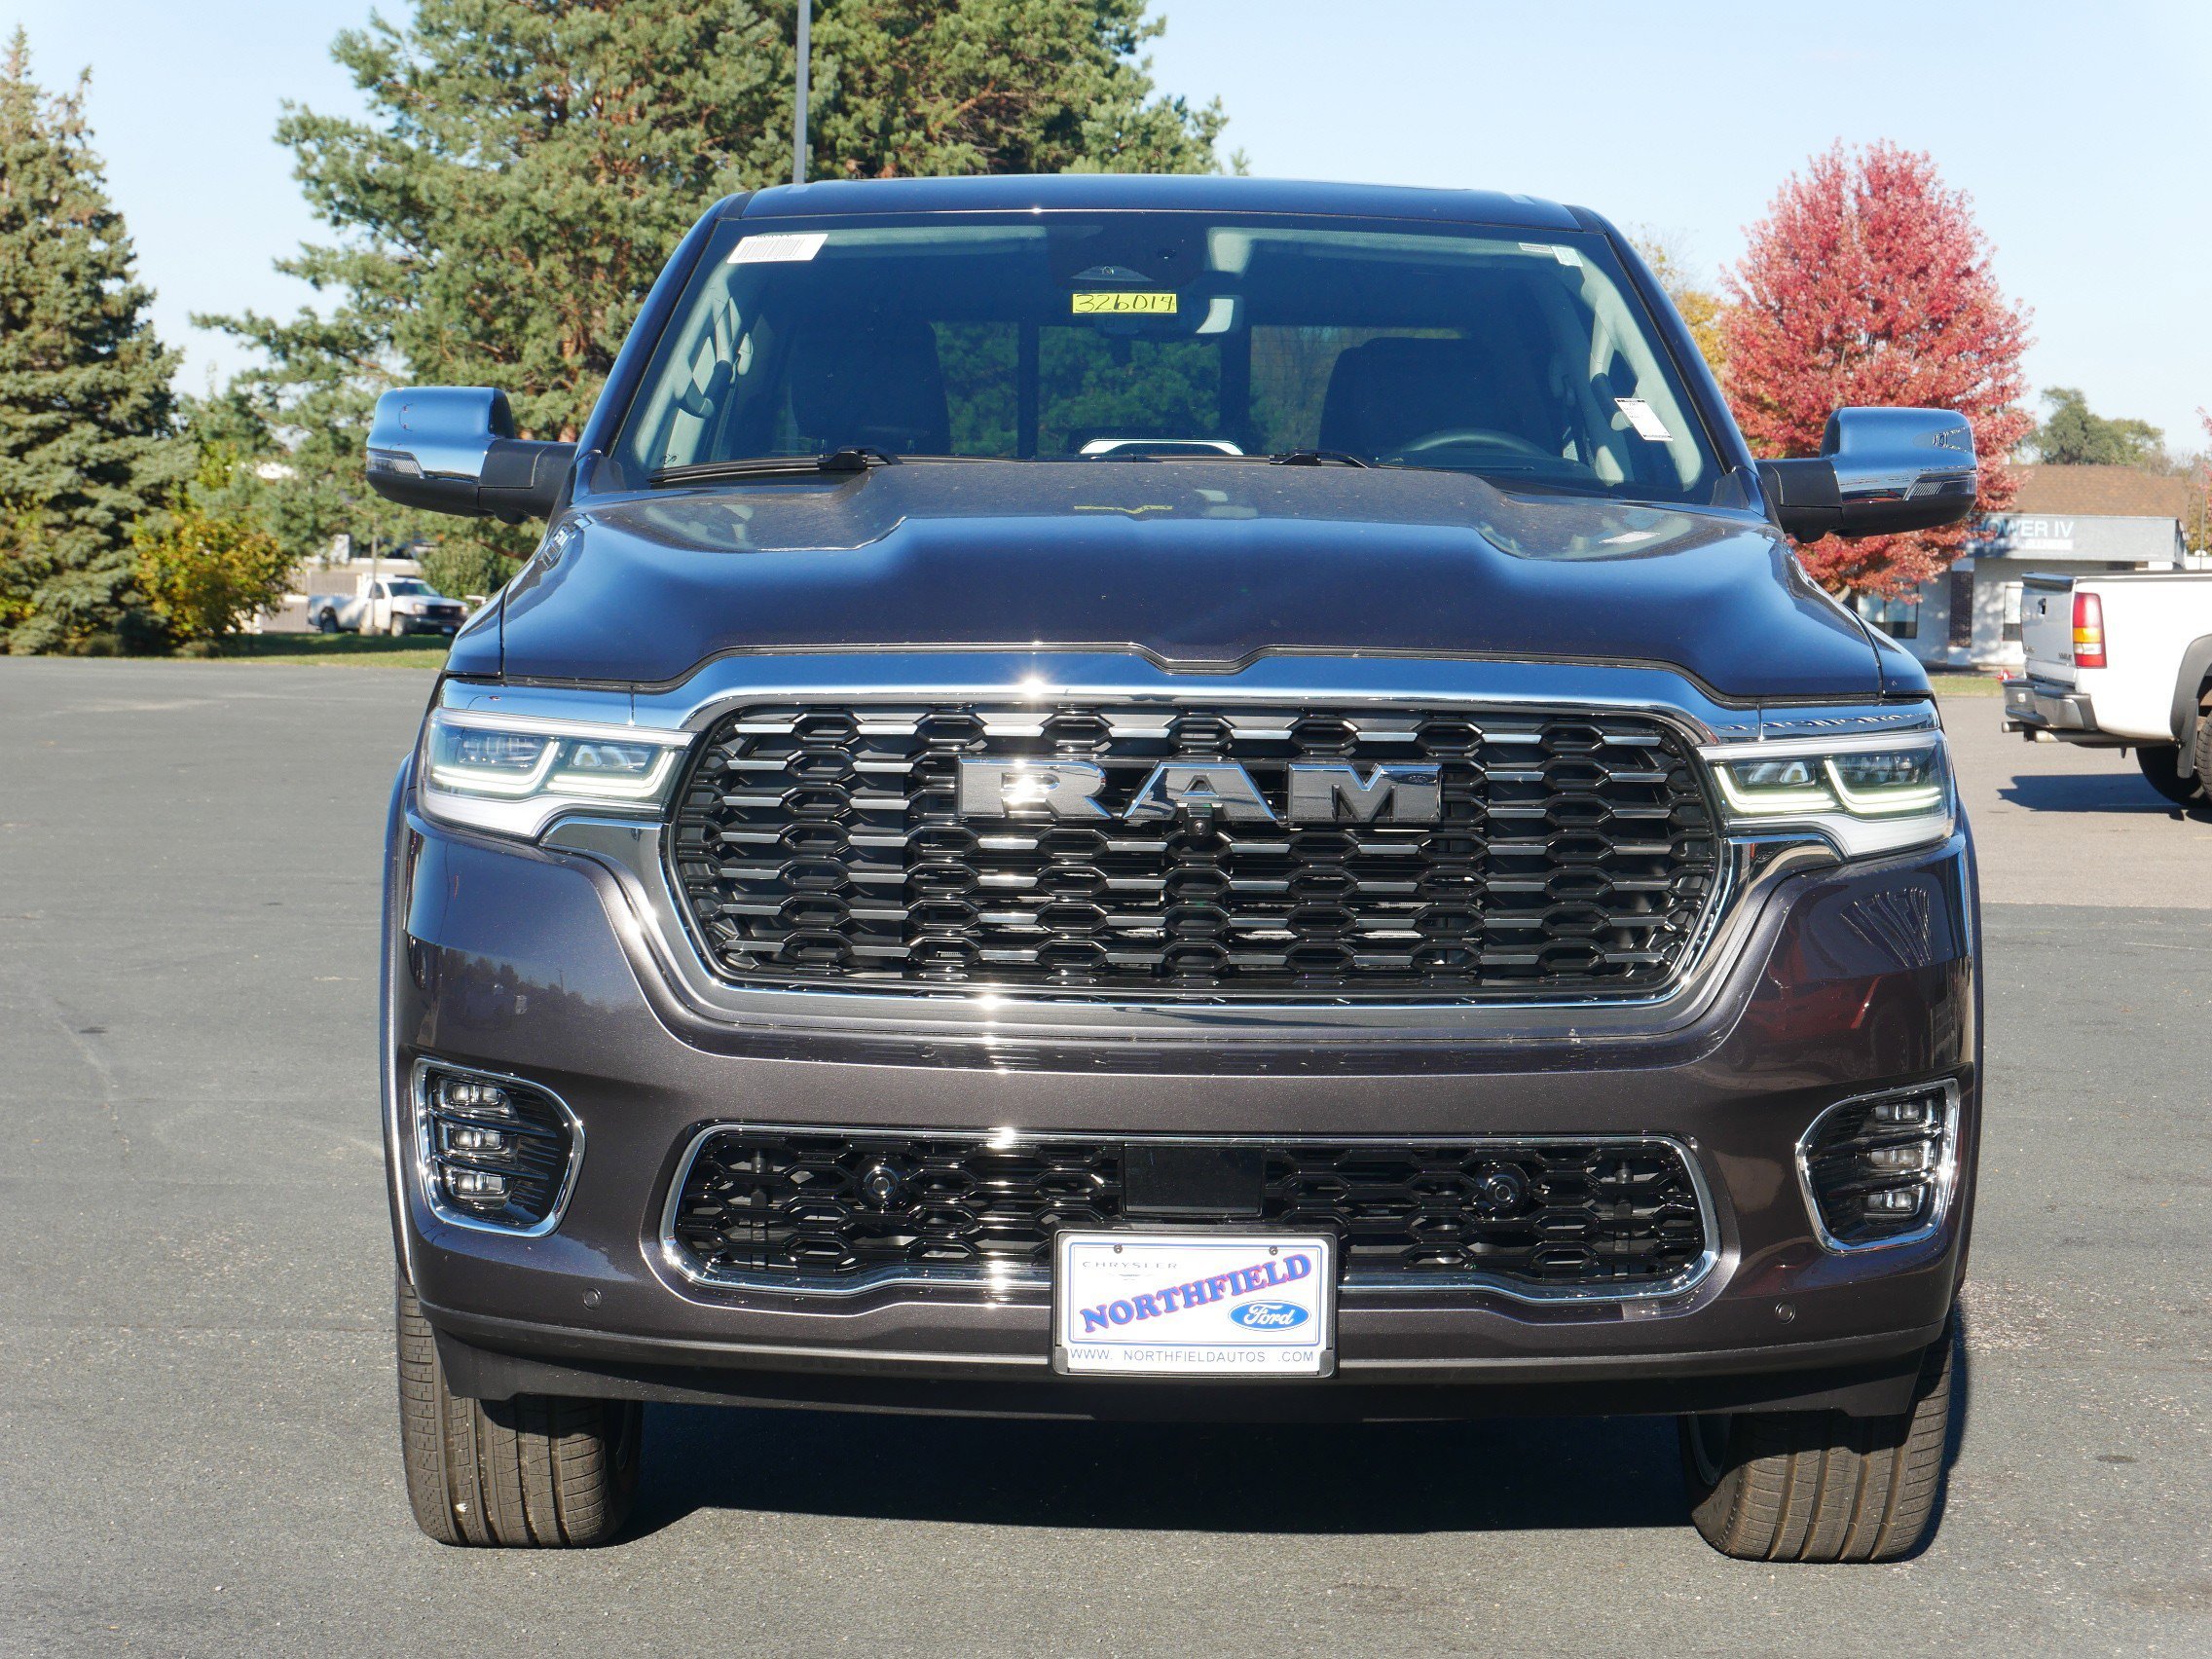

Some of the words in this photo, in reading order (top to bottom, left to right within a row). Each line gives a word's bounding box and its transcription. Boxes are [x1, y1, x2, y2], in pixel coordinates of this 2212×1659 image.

[2054, 521, 2075, 538] IV
[956, 756, 1443, 823] RAM
[1081, 1255, 1312, 1332] NORTHFIELD
[1244, 1305, 1294, 1325] Ford
[1124, 1351, 1266, 1362] NORTHFIELDAUTOS
